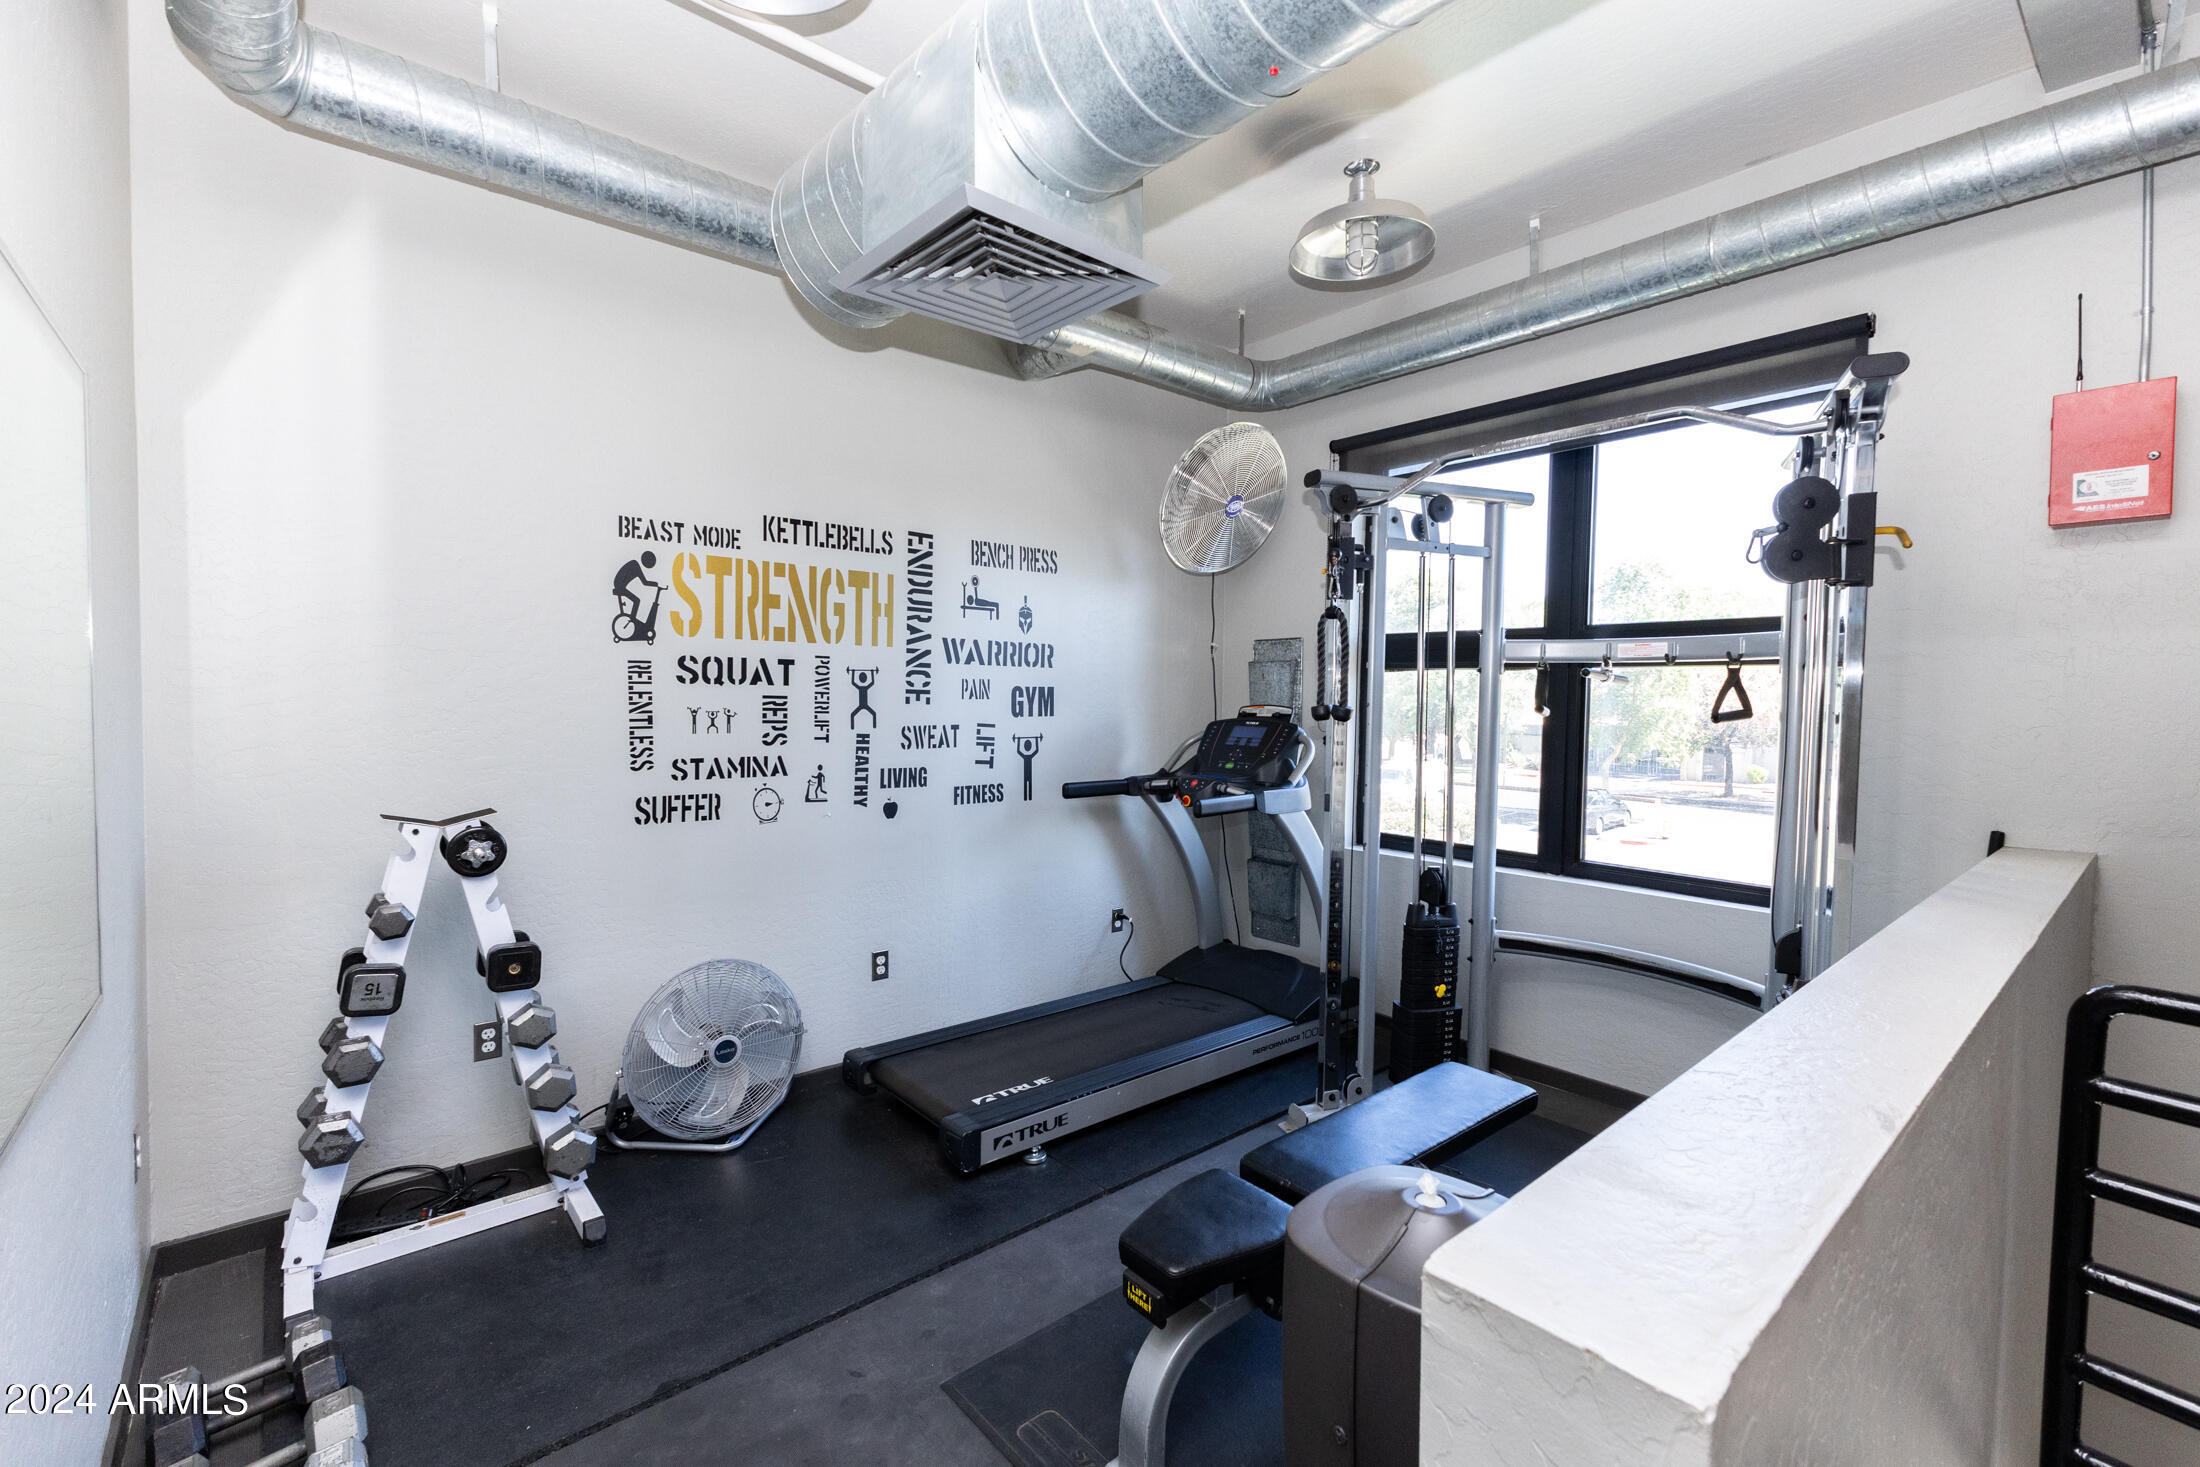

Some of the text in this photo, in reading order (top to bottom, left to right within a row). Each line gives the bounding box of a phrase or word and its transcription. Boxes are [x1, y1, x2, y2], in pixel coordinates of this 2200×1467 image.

[619, 516, 740, 549] BEAST MODE
[764, 515, 892, 555] KETTLEBELLS
[972, 540, 1057, 574] BENCH PRESS
[670, 552, 893, 646] STRENGTH
[905, 531, 933, 704] ENDURANCE
[942, 638, 1053, 668] WARRIOR
[676, 656, 795, 686] SQUAT
[814, 656, 830, 743] POWERLIFT
[962, 679, 990, 699] PAIN
[1011, 686, 1054, 718] GYM
[628, 660, 654, 771] RELENTLESS
[762, 695, 787, 746] REPS
[901, 725, 959, 749] SWEAT
[975, 723, 995, 769] LIFT
[671, 756, 788, 781] STAMINA
[854, 734, 870, 807] HEALTHY
[880, 767, 927, 788] LIVING
[635, 794, 720, 825] SUFFER
[954, 783, 1003, 805] FITNESS
[365, 983, 382, 996] 15
[1252, 1034, 1301, 1055] PERFORMANCE
[993, 1076, 1054, 1097] TRUE
[1015, 1112, 1069, 1142] TRUE
